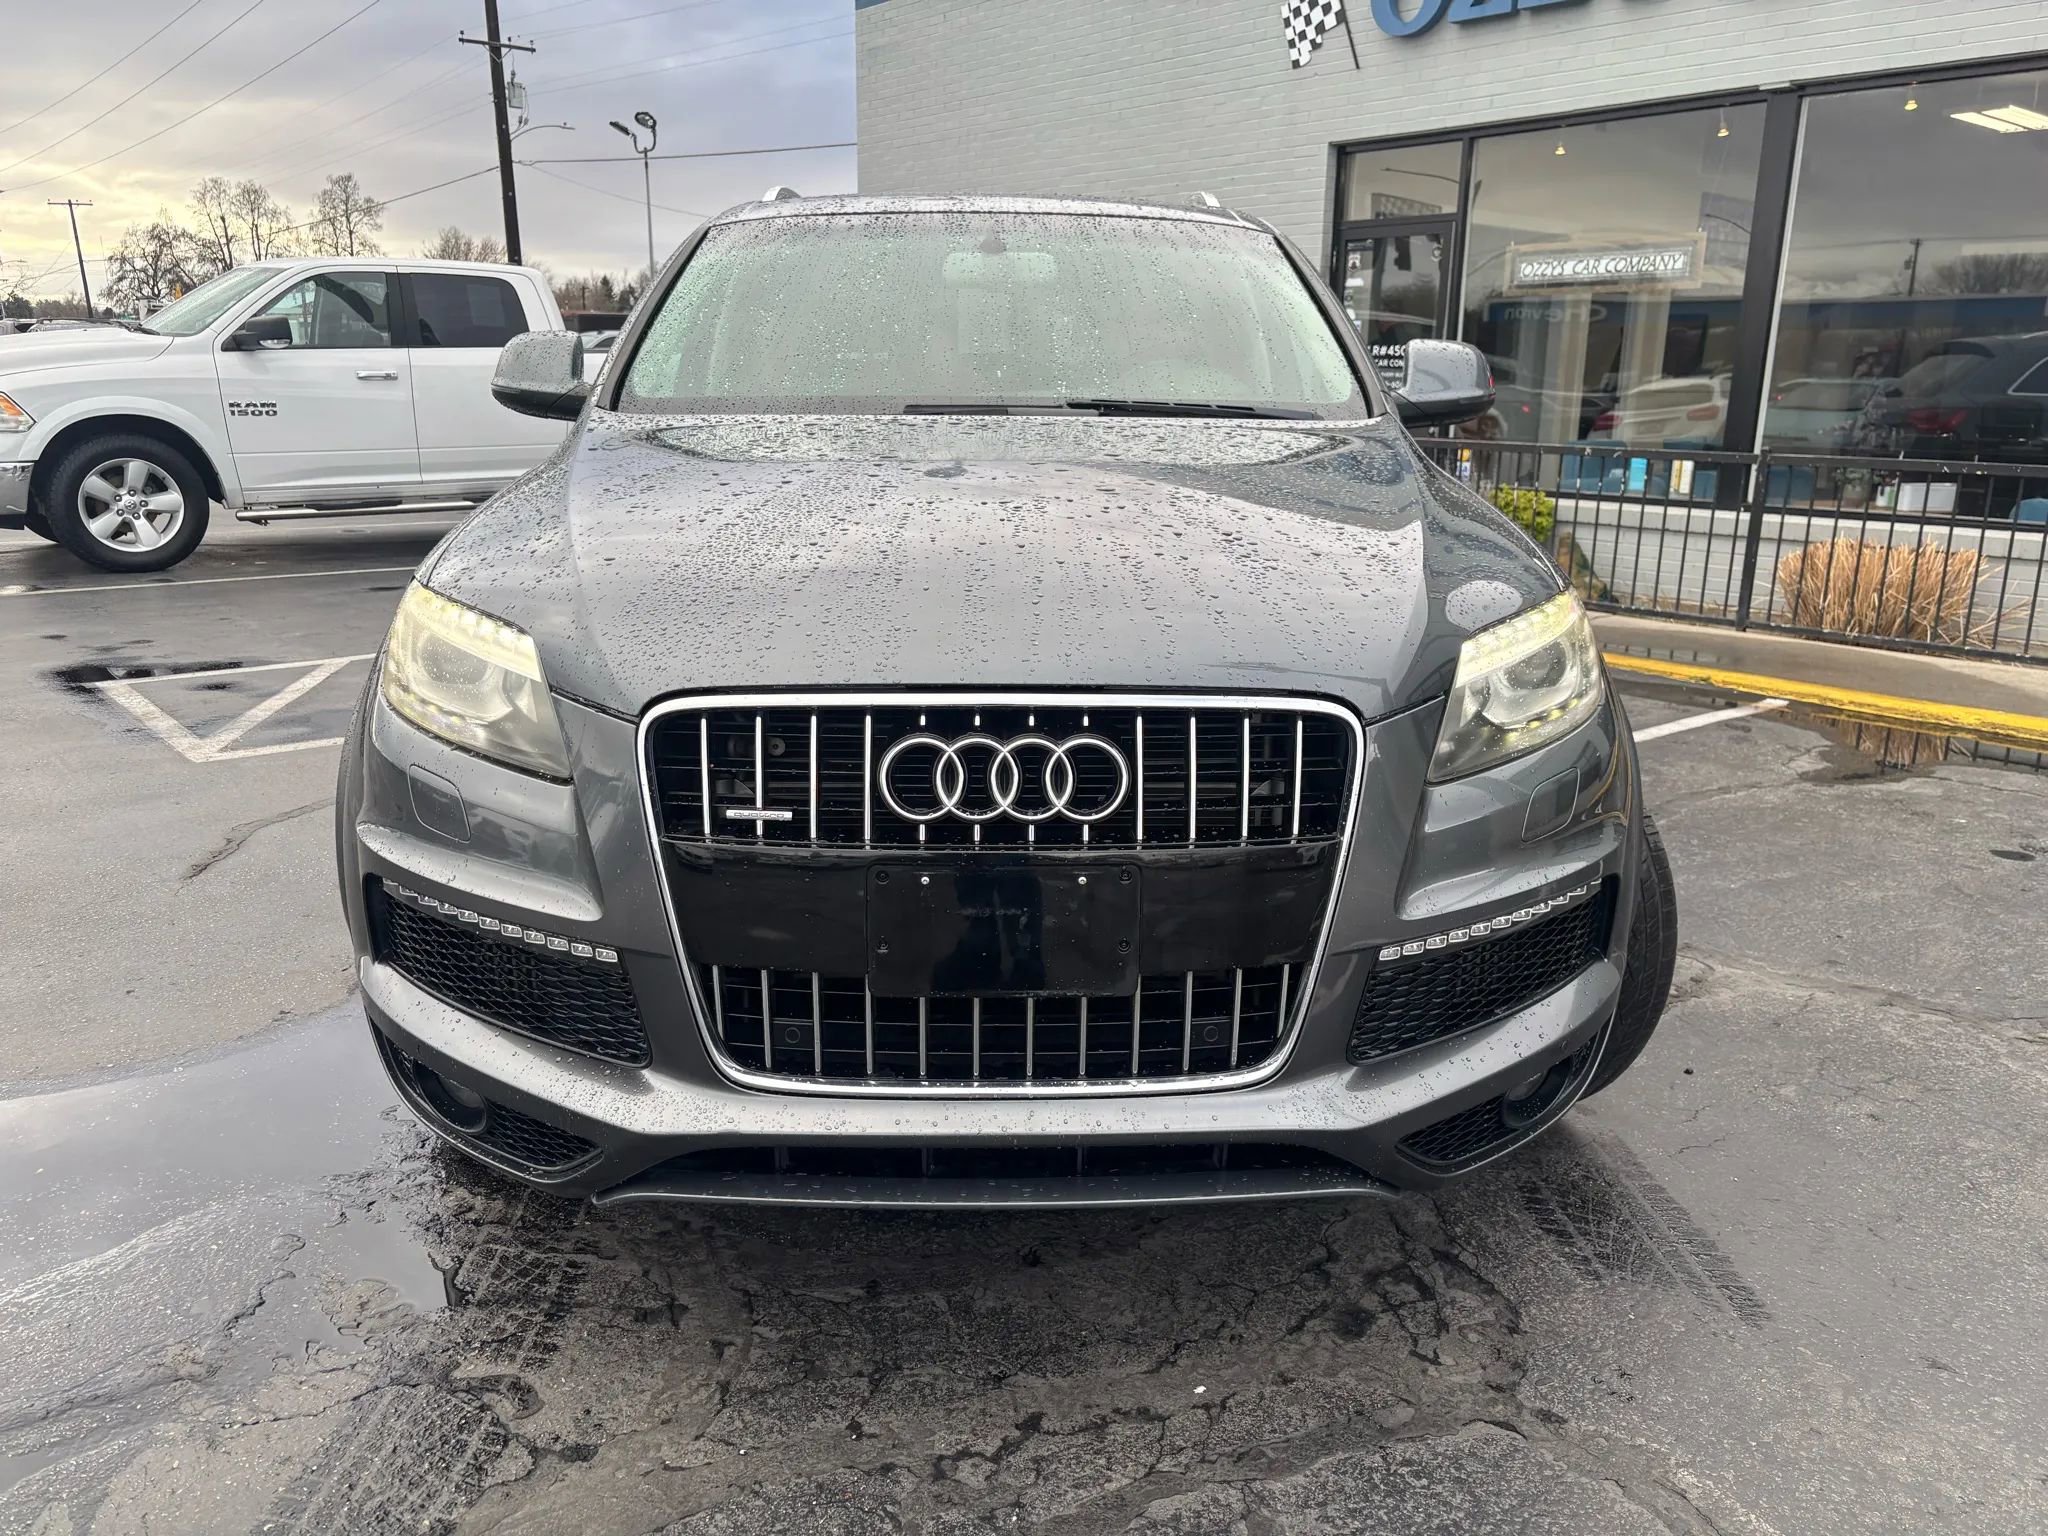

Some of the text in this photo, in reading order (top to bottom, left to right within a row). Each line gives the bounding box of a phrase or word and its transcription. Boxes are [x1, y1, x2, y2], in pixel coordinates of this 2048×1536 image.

[1572, 258, 1601, 275] CAR
[1604, 253, 1682, 274] COMPANY
[228, 401, 277, 409] RAM
[229, 409, 278, 417] 1500
